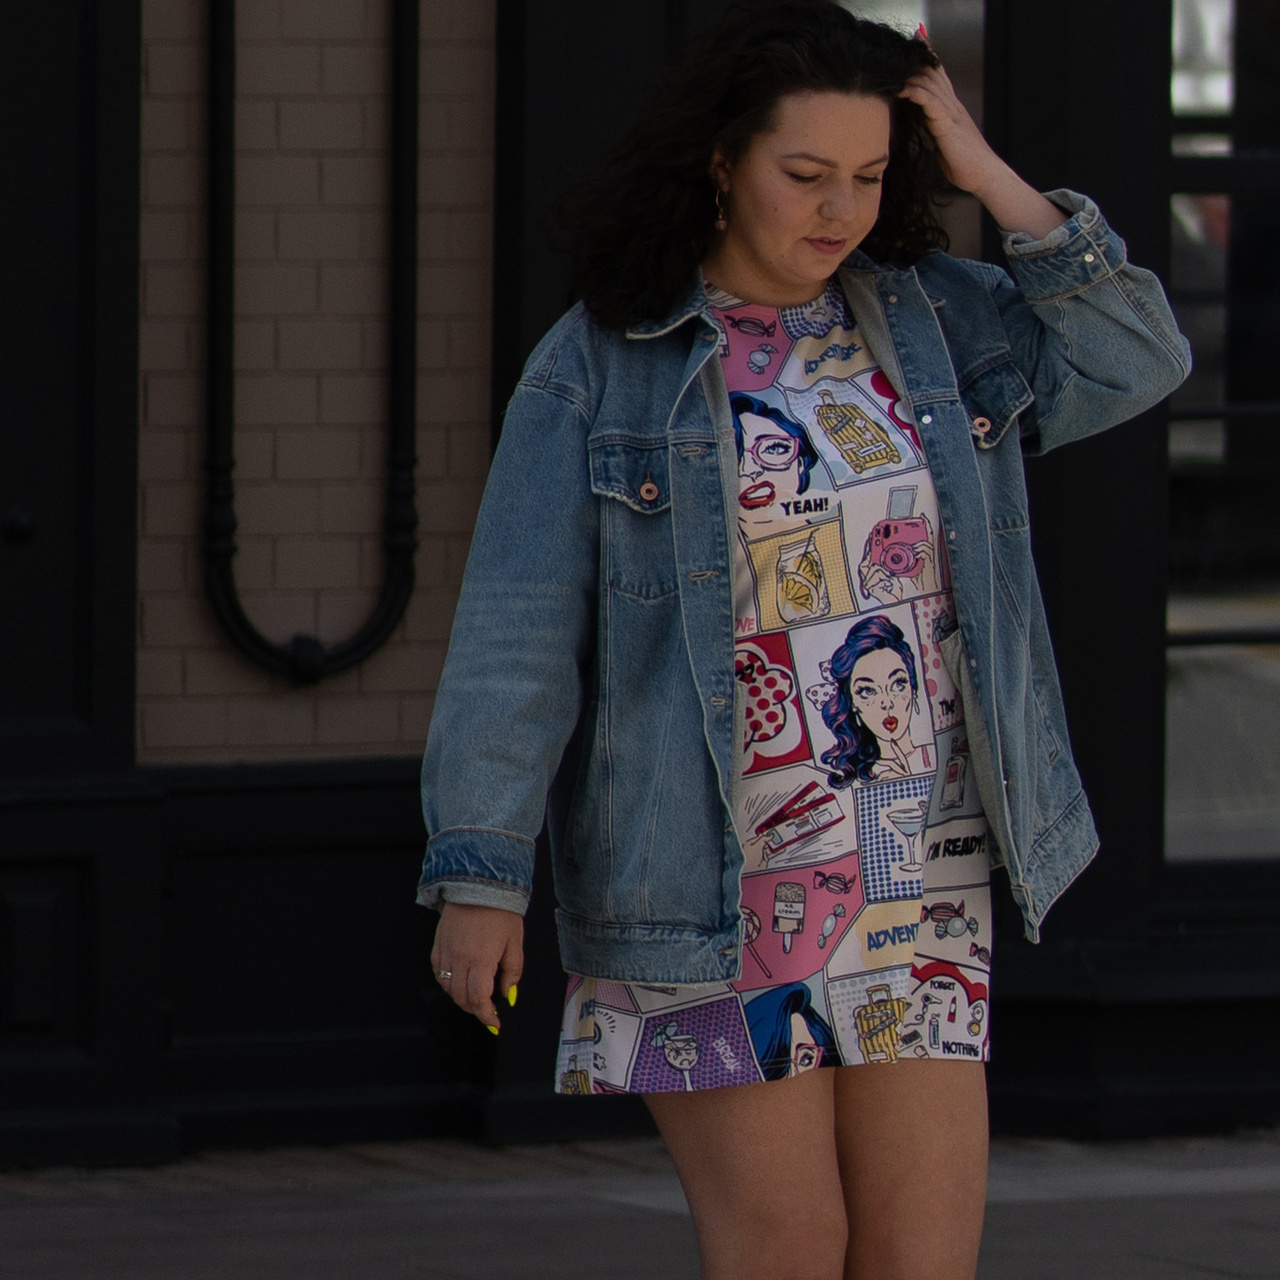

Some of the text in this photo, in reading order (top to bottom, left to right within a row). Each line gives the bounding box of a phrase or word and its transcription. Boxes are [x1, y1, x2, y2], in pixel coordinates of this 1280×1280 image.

[780, 497, 828, 516] YEAH!
[942, 833, 986, 858] READY!
[930, 980, 956, 991] FORGET
[712, 1036, 743, 1074] BREAK
